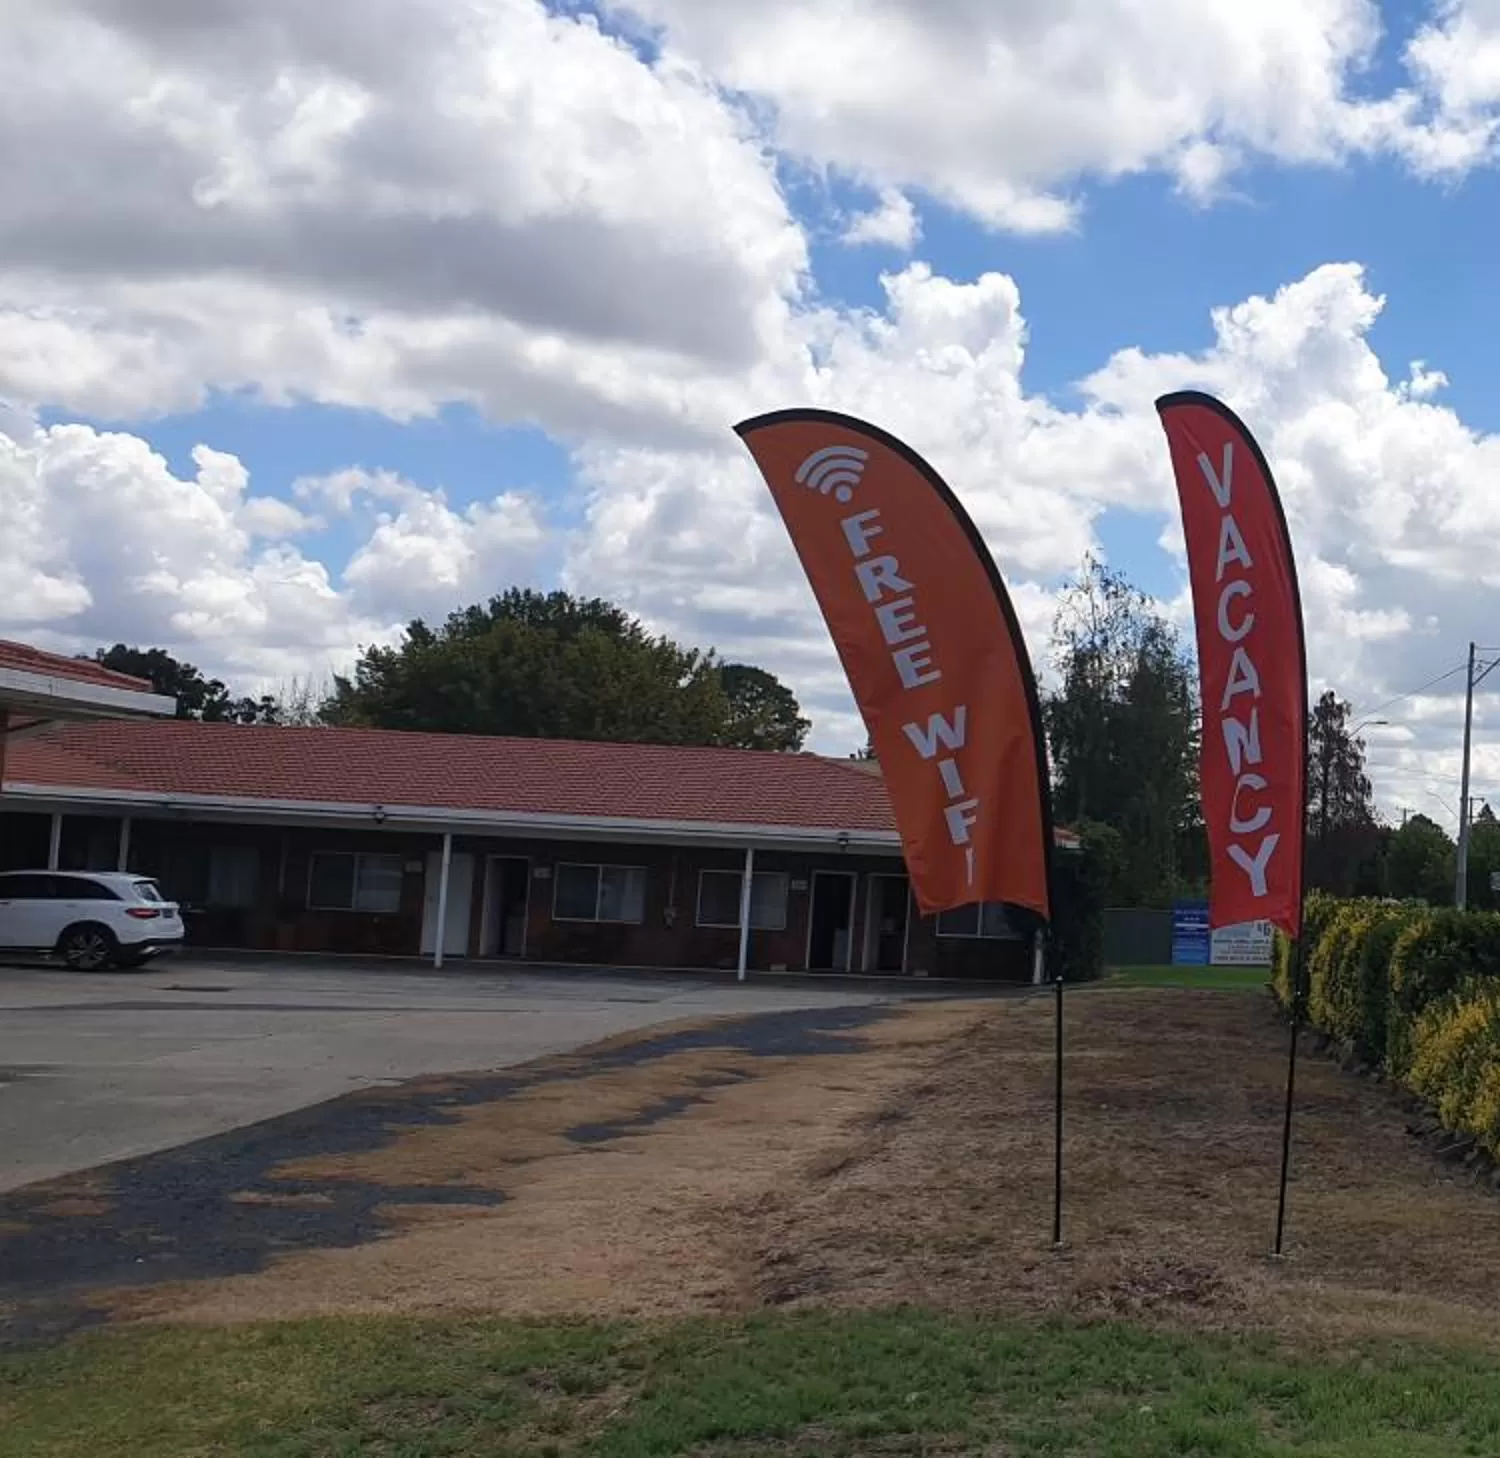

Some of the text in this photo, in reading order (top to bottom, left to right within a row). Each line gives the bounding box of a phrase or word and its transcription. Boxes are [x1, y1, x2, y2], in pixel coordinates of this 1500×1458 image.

[840, 508, 979, 886] FREE WIFI
[1197, 442, 1280, 897] VACANCY
